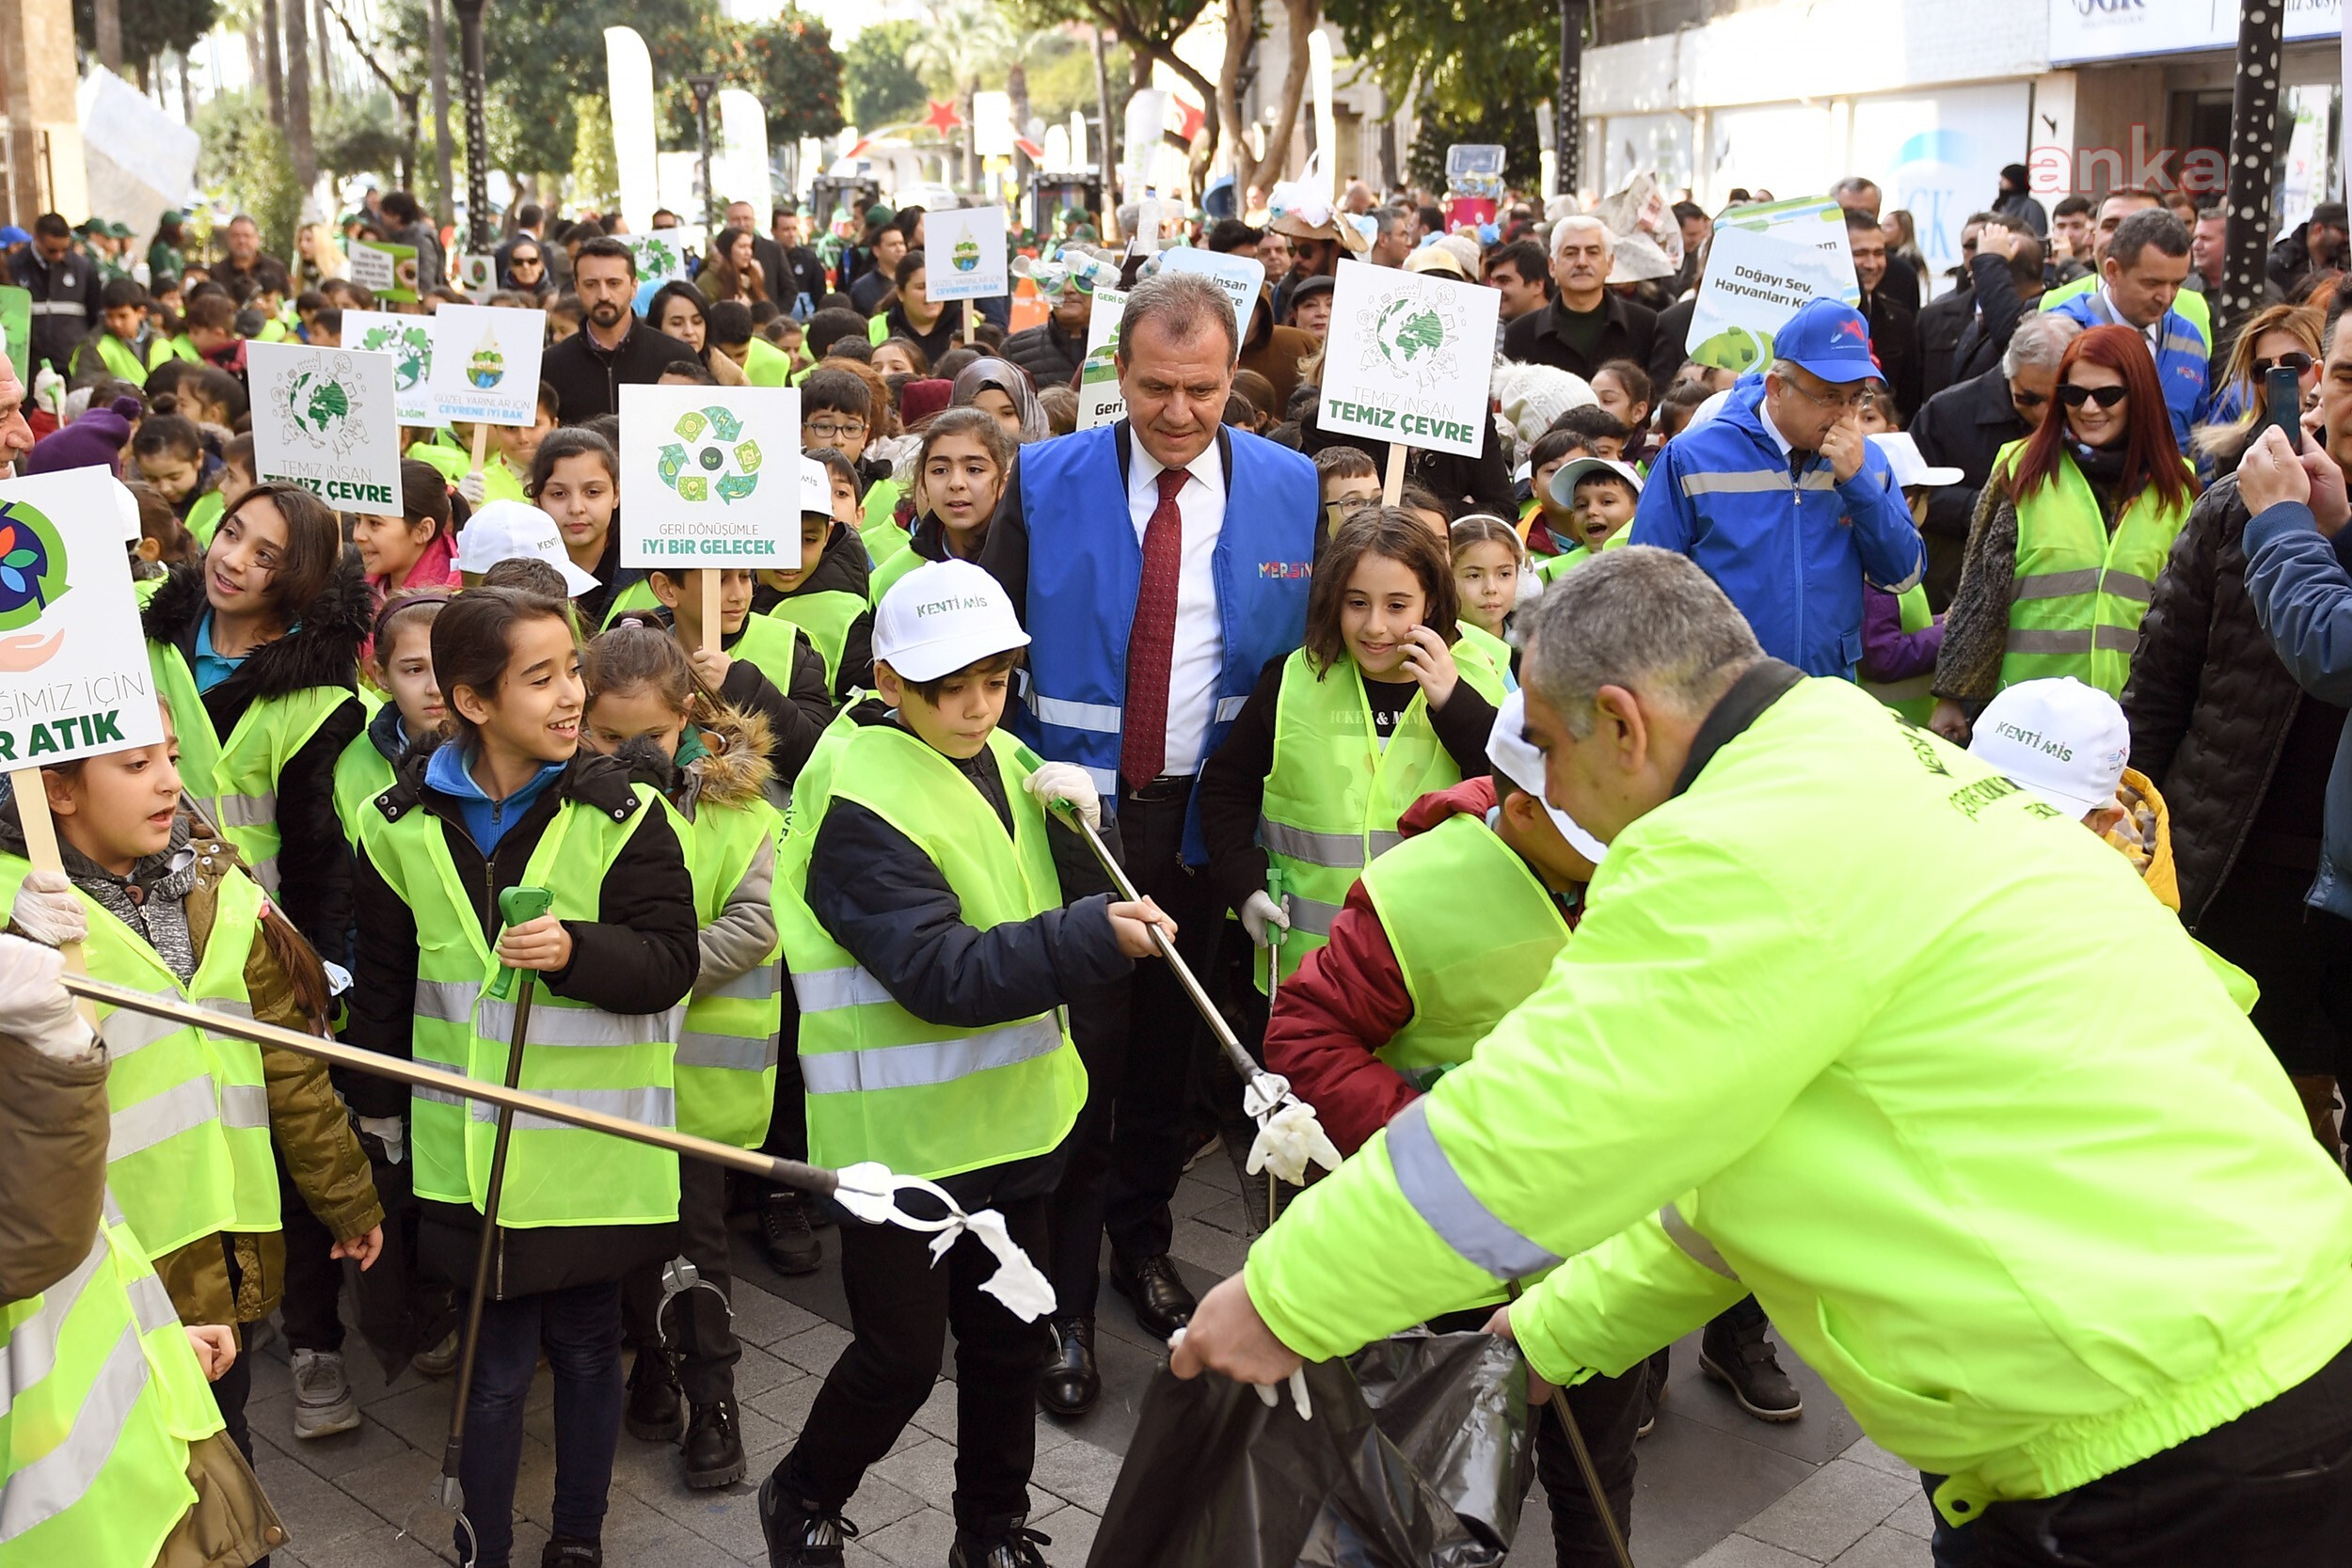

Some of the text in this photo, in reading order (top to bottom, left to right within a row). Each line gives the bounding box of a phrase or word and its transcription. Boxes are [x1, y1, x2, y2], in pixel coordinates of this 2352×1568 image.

[1714, 277, 1790, 306] Hayvanları
[1734, 265, 1813, 295] Doğayı Sev,
[435, 393, 463, 404] GÜZEL
[466, 395, 512, 407] YARINLAR
[1095, 399, 1122, 416] Geri
[438, 404, 485, 417] ÇEVRENE
[502, 409, 523, 420] BAK
[1400, 413, 1474, 444] ÇEVRE
[326, 481, 393, 504] ÇEVRE
[660, 522, 759, 536] GERİ DÖNÜŞÜMLE
[700, 539, 776, 555] GELECEK
[916, 594, 961, 618] KENTİ
[85, 672, 145, 706] İÇİN
[1376, 712, 1389, 725] &
[28, 709, 126, 757] ATIK
[1995, 721, 2042, 748] KENTİ
